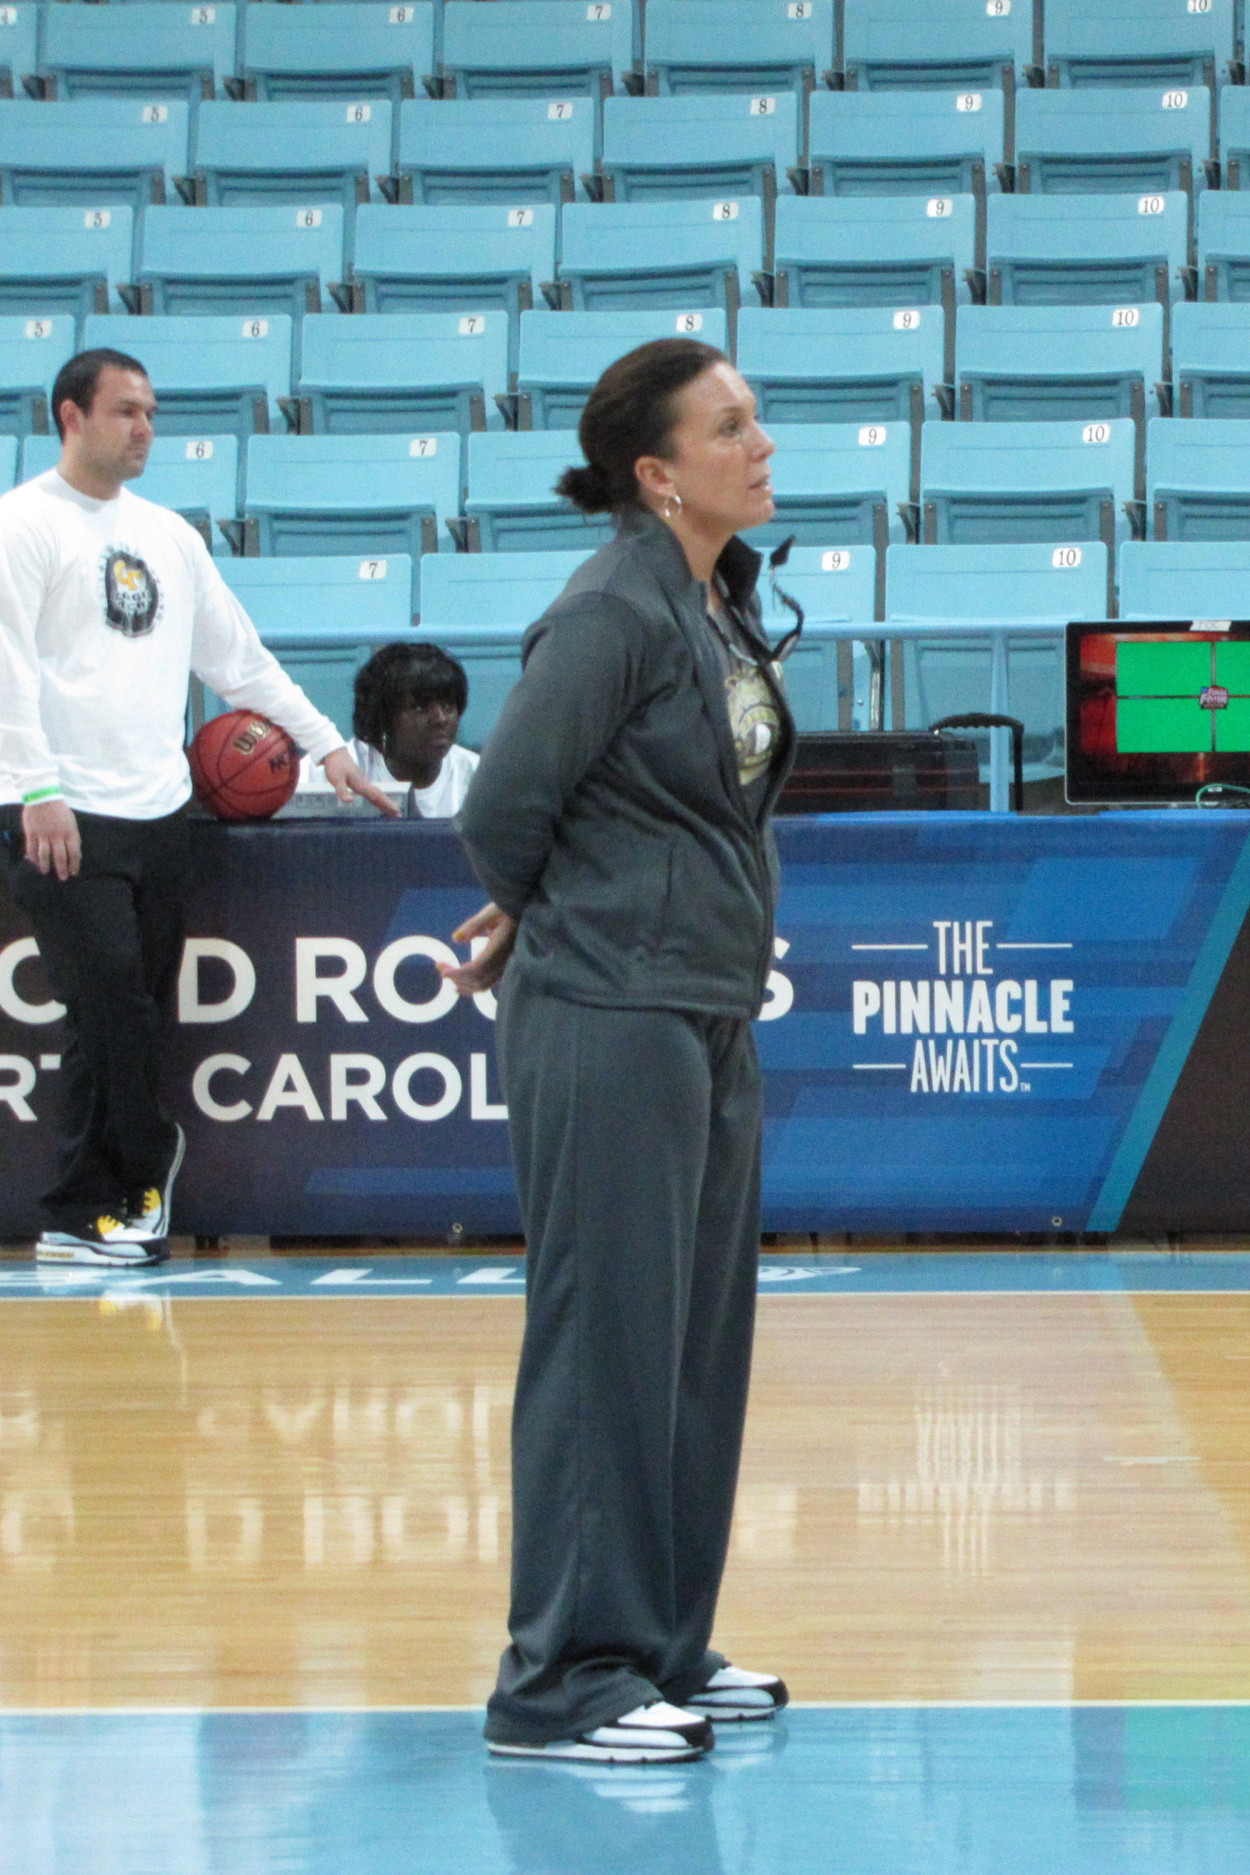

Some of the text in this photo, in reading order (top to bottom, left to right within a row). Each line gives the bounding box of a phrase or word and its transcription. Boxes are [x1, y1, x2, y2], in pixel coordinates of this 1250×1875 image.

[396, 8, 406, 22] 6
[594, 5, 604, 20] 7
[795, 3, 805, 18] 8
[994, 0, 1004, 15] 9
[198, 9, 208, 24] 5
[758, 98, 768, 114] 8
[964, 94, 974, 110] 9
[1167, 92, 1184, 107] 10
[150, 106, 160, 121] 5
[354, 106, 364, 121] 6
[556, 103, 565, 118] 7
[721, 203, 731, 219] 8
[936, 199, 945, 217] 9
[1142, 196, 1160, 213] 10
[93, 211, 103, 227] 5
[304, 211, 314, 226] 6
[516, 209, 526, 225] 7
[467, 317, 477, 334] 7
[685, 314, 695, 331] 8
[902, 311, 912, 328] 9
[1117, 309, 1135, 326] 10
[34, 320, 44, 337] 5
[250, 320, 260, 336] 6
[868, 427, 878, 446] 9
[1087, 425, 1105, 443] 10
[195, 441, 205, 459] 6
[419, 438, 429, 456] 7
[831, 551, 842, 568] 9
[1059, 548, 1077, 567] 10
[368, 561, 379, 578] 7
[932, 920, 993, 975] THE
[852, 979, 1074, 1035] PINNACLE
[910, 1038, 1018, 1093] AWAITS
